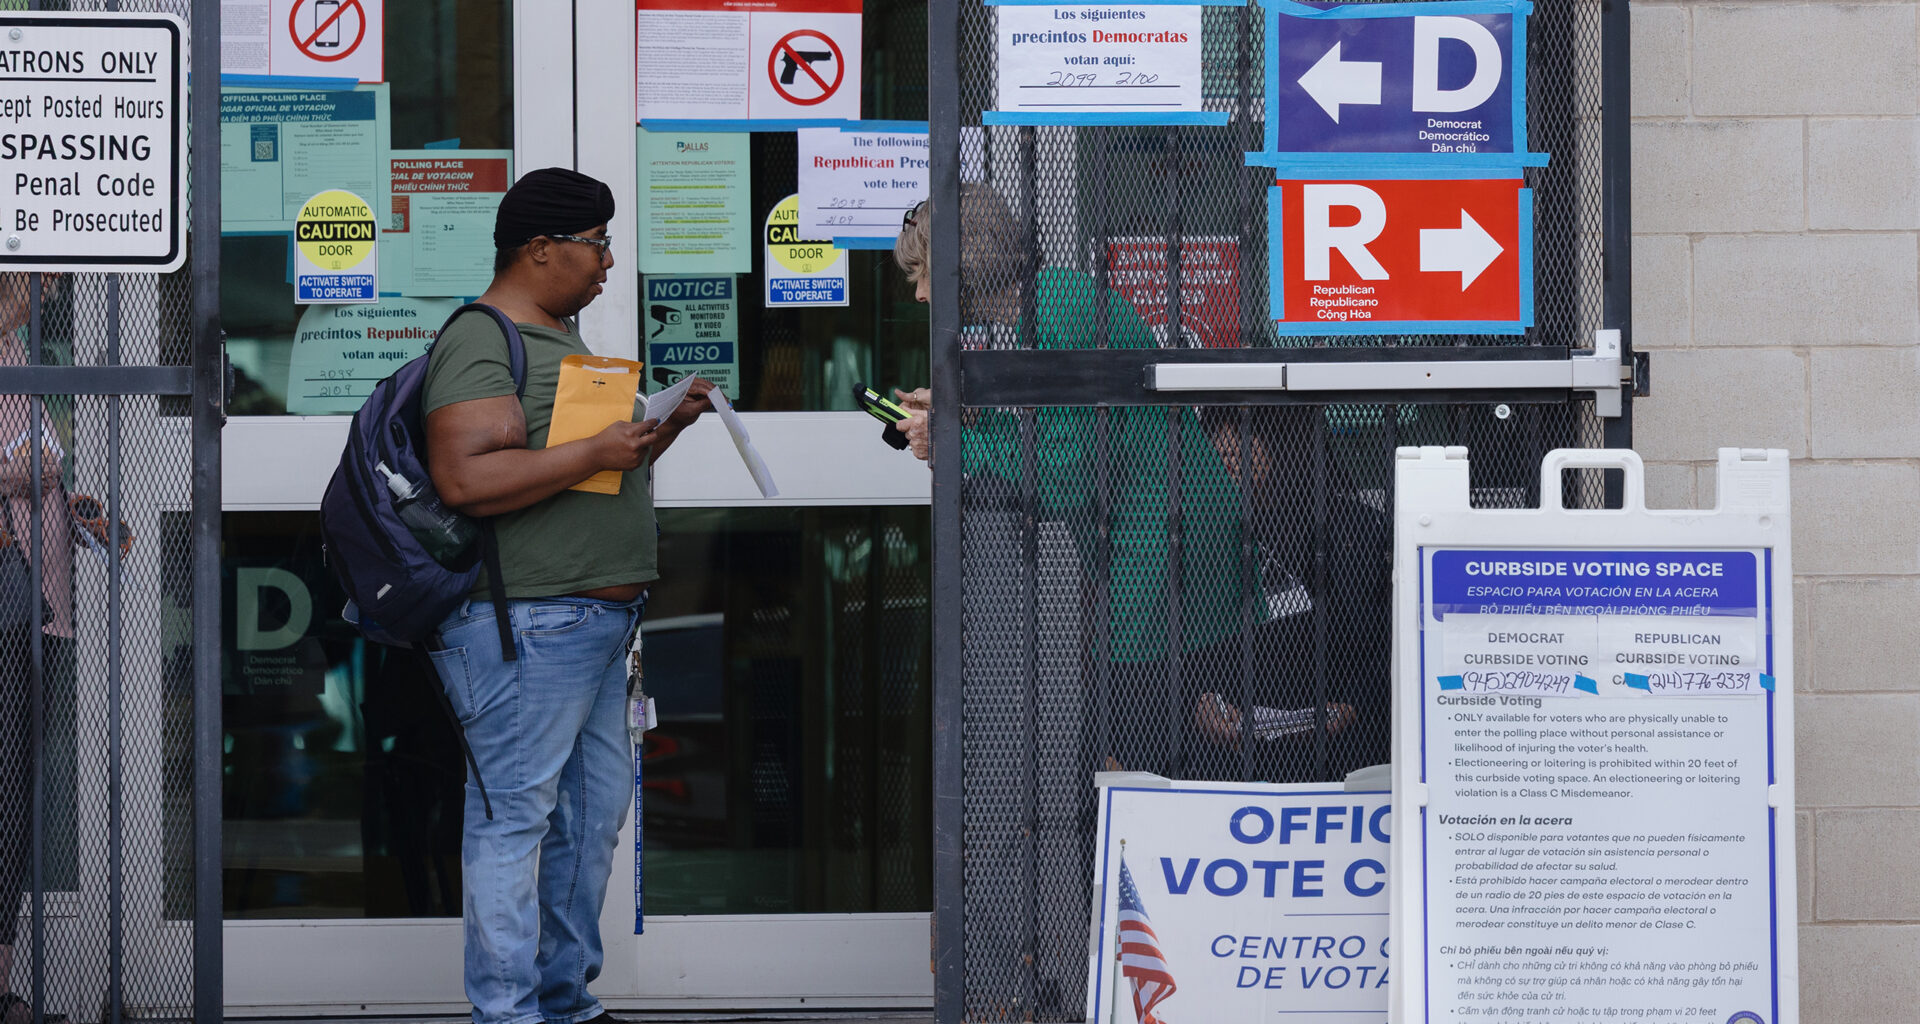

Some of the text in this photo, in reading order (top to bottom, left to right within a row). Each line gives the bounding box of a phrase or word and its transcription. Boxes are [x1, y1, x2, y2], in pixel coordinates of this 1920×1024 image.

[1054, 8, 1145, 21] Los siguientes
[1012, 29, 1187, 46] precintos Democratas
[101, 51, 157, 73] ONLY
[1063, 54, 1135, 67] votan aquí:
[1412, 15, 1503, 113] D
[1115, 72, 1159, 85] 2100
[223, 93, 327, 104] OFFICIAL POLLING PLACE
[43, 94, 101, 118] Posted
[114, 96, 163, 118] Hours
[245, 104, 277, 113] OFICIAL
[279, 104, 290, 113] DE
[1427, 118, 1482, 131] Democrat
[853, 136, 929, 148] The following
[1419, 130, 1490, 143] Democrático
[0, 133, 150, 161] SPASSING
[1431, 143, 1455, 153] Dân
[393, 161, 432, 169] POLLING
[813, 155, 894, 170] Republican
[15, 171, 154, 196] Penal Code
[863, 178, 917, 188] vote here
[303, 206, 368, 217] AUTOMATIC
[15, 208, 162, 232] Be Prosecuted
[299, 224, 373, 240] CAUTION
[1303, 184, 1390, 281] R
[319, 245, 353, 256] DOOR
[789, 248, 823, 259] DOOR
[301, 276, 373, 287] ACTIVATE SWITCH
[772, 279, 843, 290] ACTIVATE SWITCH
[311, 287, 362, 298] TO OPERATE
[654, 281, 727, 298] NOTICE
[782, 290, 833, 301] TO OPERATE
[1313, 284, 1375, 297] Republican
[697, 303, 730, 311] ACTIVITIES
[1310, 297, 1379, 309] Republicano
[334, 308, 417, 318] Los siguientes
[1317, 308, 1372, 321] Cộng Hòa
[300, 327, 361, 343] precintos
[342, 350, 374, 359] votan
[663, 345, 720, 361] AVISO
[1465, 561, 1723, 576] CURBSIDE VOTING SPACE
[1466, 585, 1718, 597] ESPACIO PARA VOTACIÓN EN LA ACERA
[237, 568, 313, 650] D
[1488, 633, 1565, 644] DEMOCRAT
[1634, 634, 1721, 645] REPUBLICAN
[1463, 653, 1588, 665] CURBSIDE VOTING
[1615, 652, 1739, 665] CURBSIDE VOTING
[1436, 693, 1543, 708] Curbside Voting
[1453, 712, 1483, 721] ONLY
[1485, 713, 1530, 722] available
[1532, 713, 1547, 722] for
[1549, 714, 1582, 722] voters
[1584, 713, 1606, 722] who
[1628, 713, 1678, 724] physically
[1680, 714, 1715, 722] unable
[1717, 714, 1728, 722] to
[1454, 743, 1502, 752] likelihood
[1505, 742, 1515, 752] of
[1518, 743, 1555, 754] injuring
[1558, 743, 1575, 752] the
[1614, 743, 1648, 752] health.
[1438, 814, 1572, 825] Votación en la acera
[1454, 832, 1485, 841] SOLO
[1486, 832, 1537, 843] disponible
[1539, 834, 1563, 843] para
[1566, 833, 1609, 841] votantes
[1611, 835, 1630, 843] que
[1647, 833, 1685, 843] pueden
[1160, 857, 1324, 897] VOTE
[1211, 935, 1366, 959] CENTRO
[1236, 966, 1286, 989] DE
